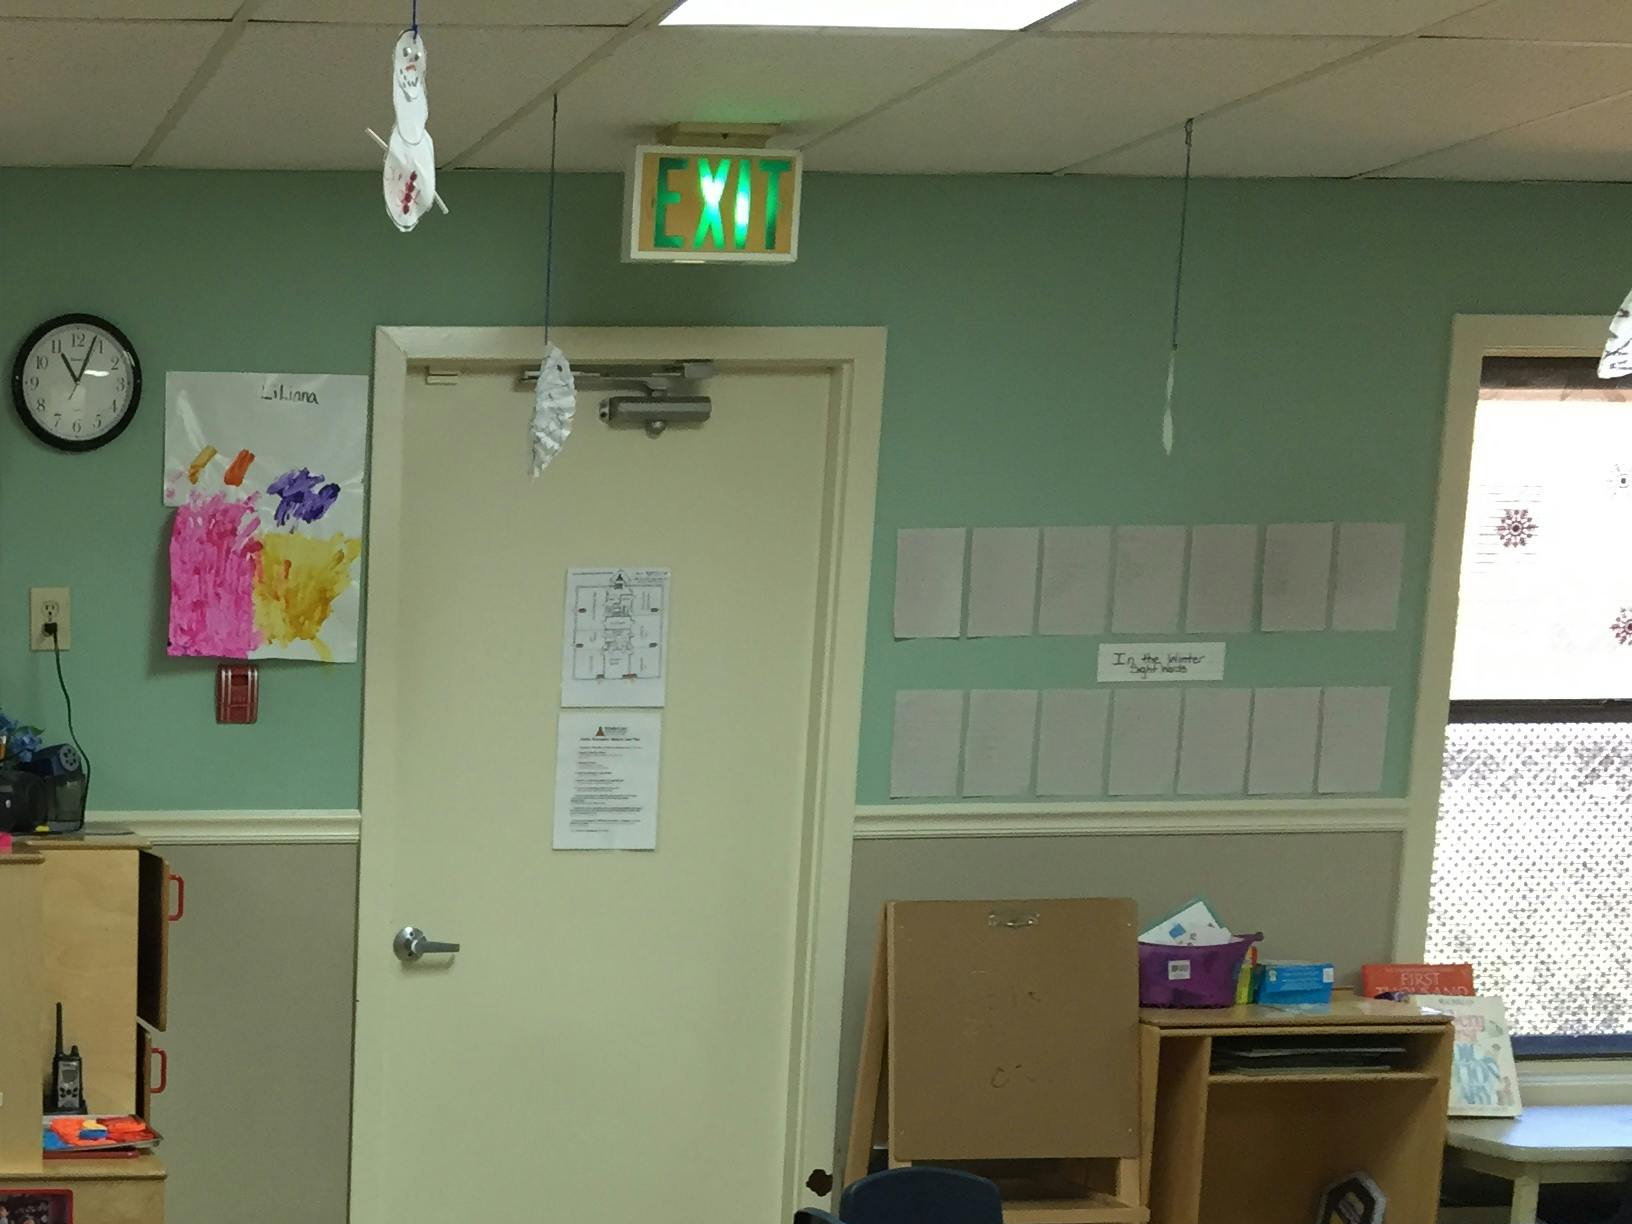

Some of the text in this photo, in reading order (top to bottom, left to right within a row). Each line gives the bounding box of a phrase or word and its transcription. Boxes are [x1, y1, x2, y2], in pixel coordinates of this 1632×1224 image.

[653, 156, 792, 251] EXIT
[50, 339, 62, 354] 11
[70, 333, 86, 348] 12
[35, 355, 48, 370] 10
[110, 356, 119, 370] 2
[30, 376, 39, 391] 9
[36, 398, 46, 411] 8
[54, 412, 62, 427] 7
[71, 418, 81, 433] 6
[92, 413, 102, 428] 5
[1111, 652, 1136, 666] In
[1400, 972, 1440, 986] FIRST
